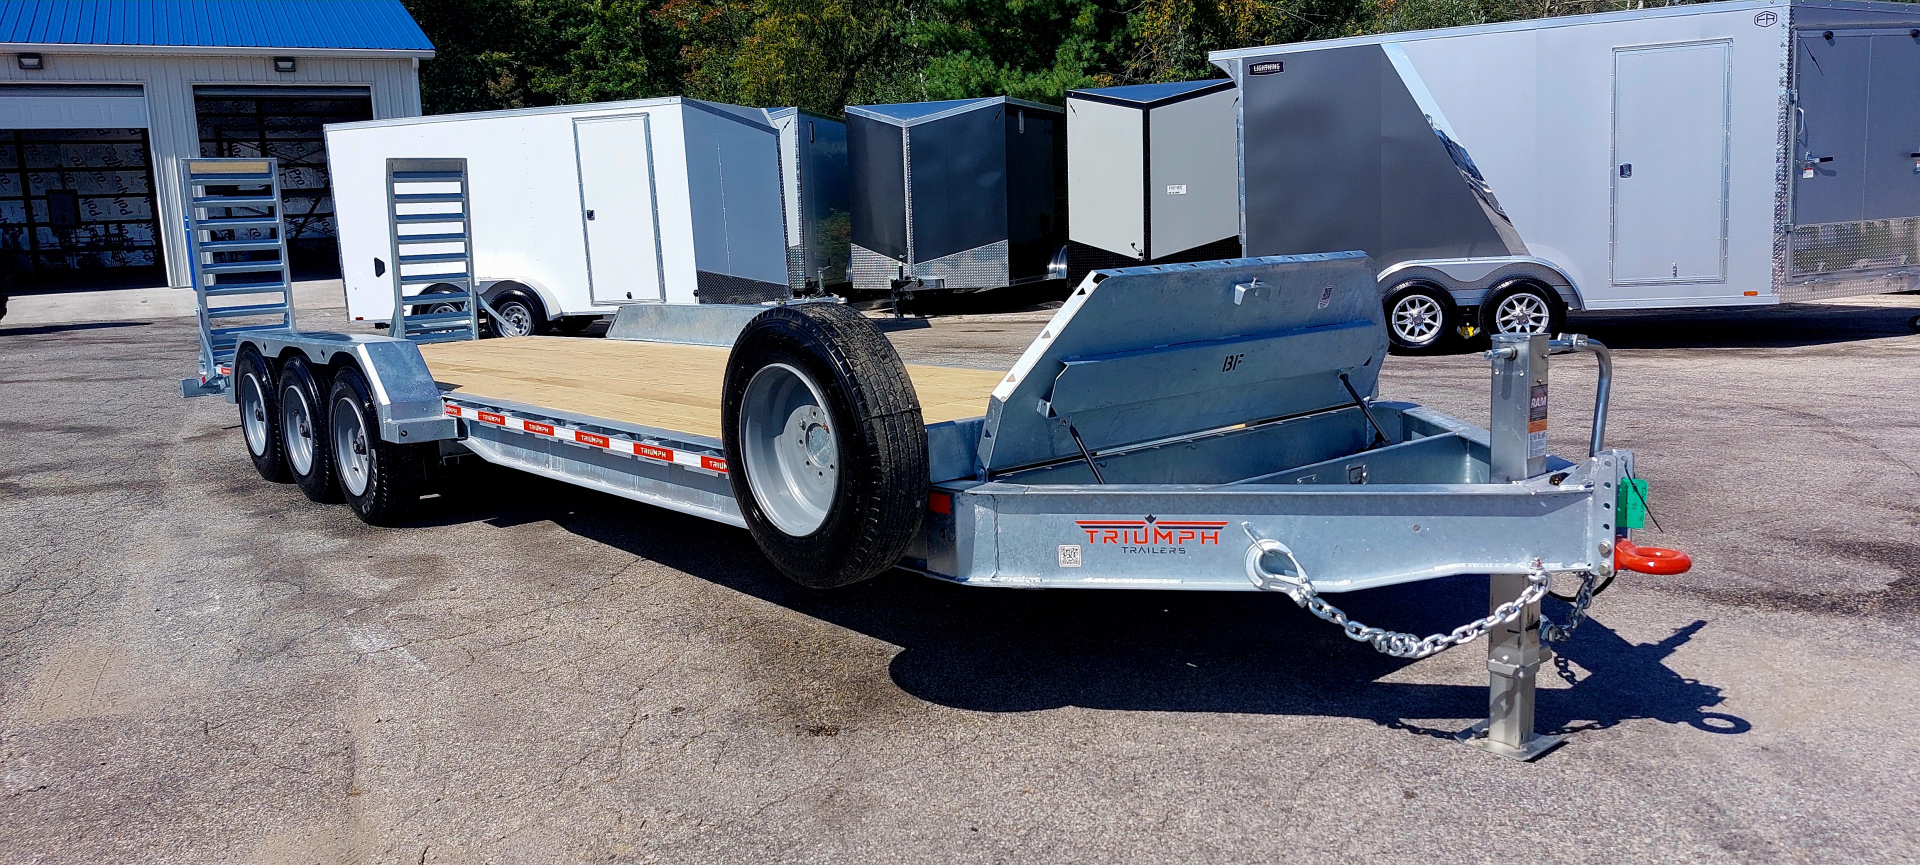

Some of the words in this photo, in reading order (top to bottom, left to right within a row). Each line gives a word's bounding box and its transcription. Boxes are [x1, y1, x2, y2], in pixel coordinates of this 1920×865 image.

[1222, 353, 1245, 372] BF
[1530, 395, 1547, 409] RAM
[482, 413, 501, 424] TRIUMPH
[528, 422, 549, 434] TRIUMPH
[580, 434, 604, 445] TRIUMPH
[639, 446, 667, 459] TRIUMPH
[1085, 526, 1220, 545] TRIUMPH
[1122, 546, 1186, 555] TRAILERS
